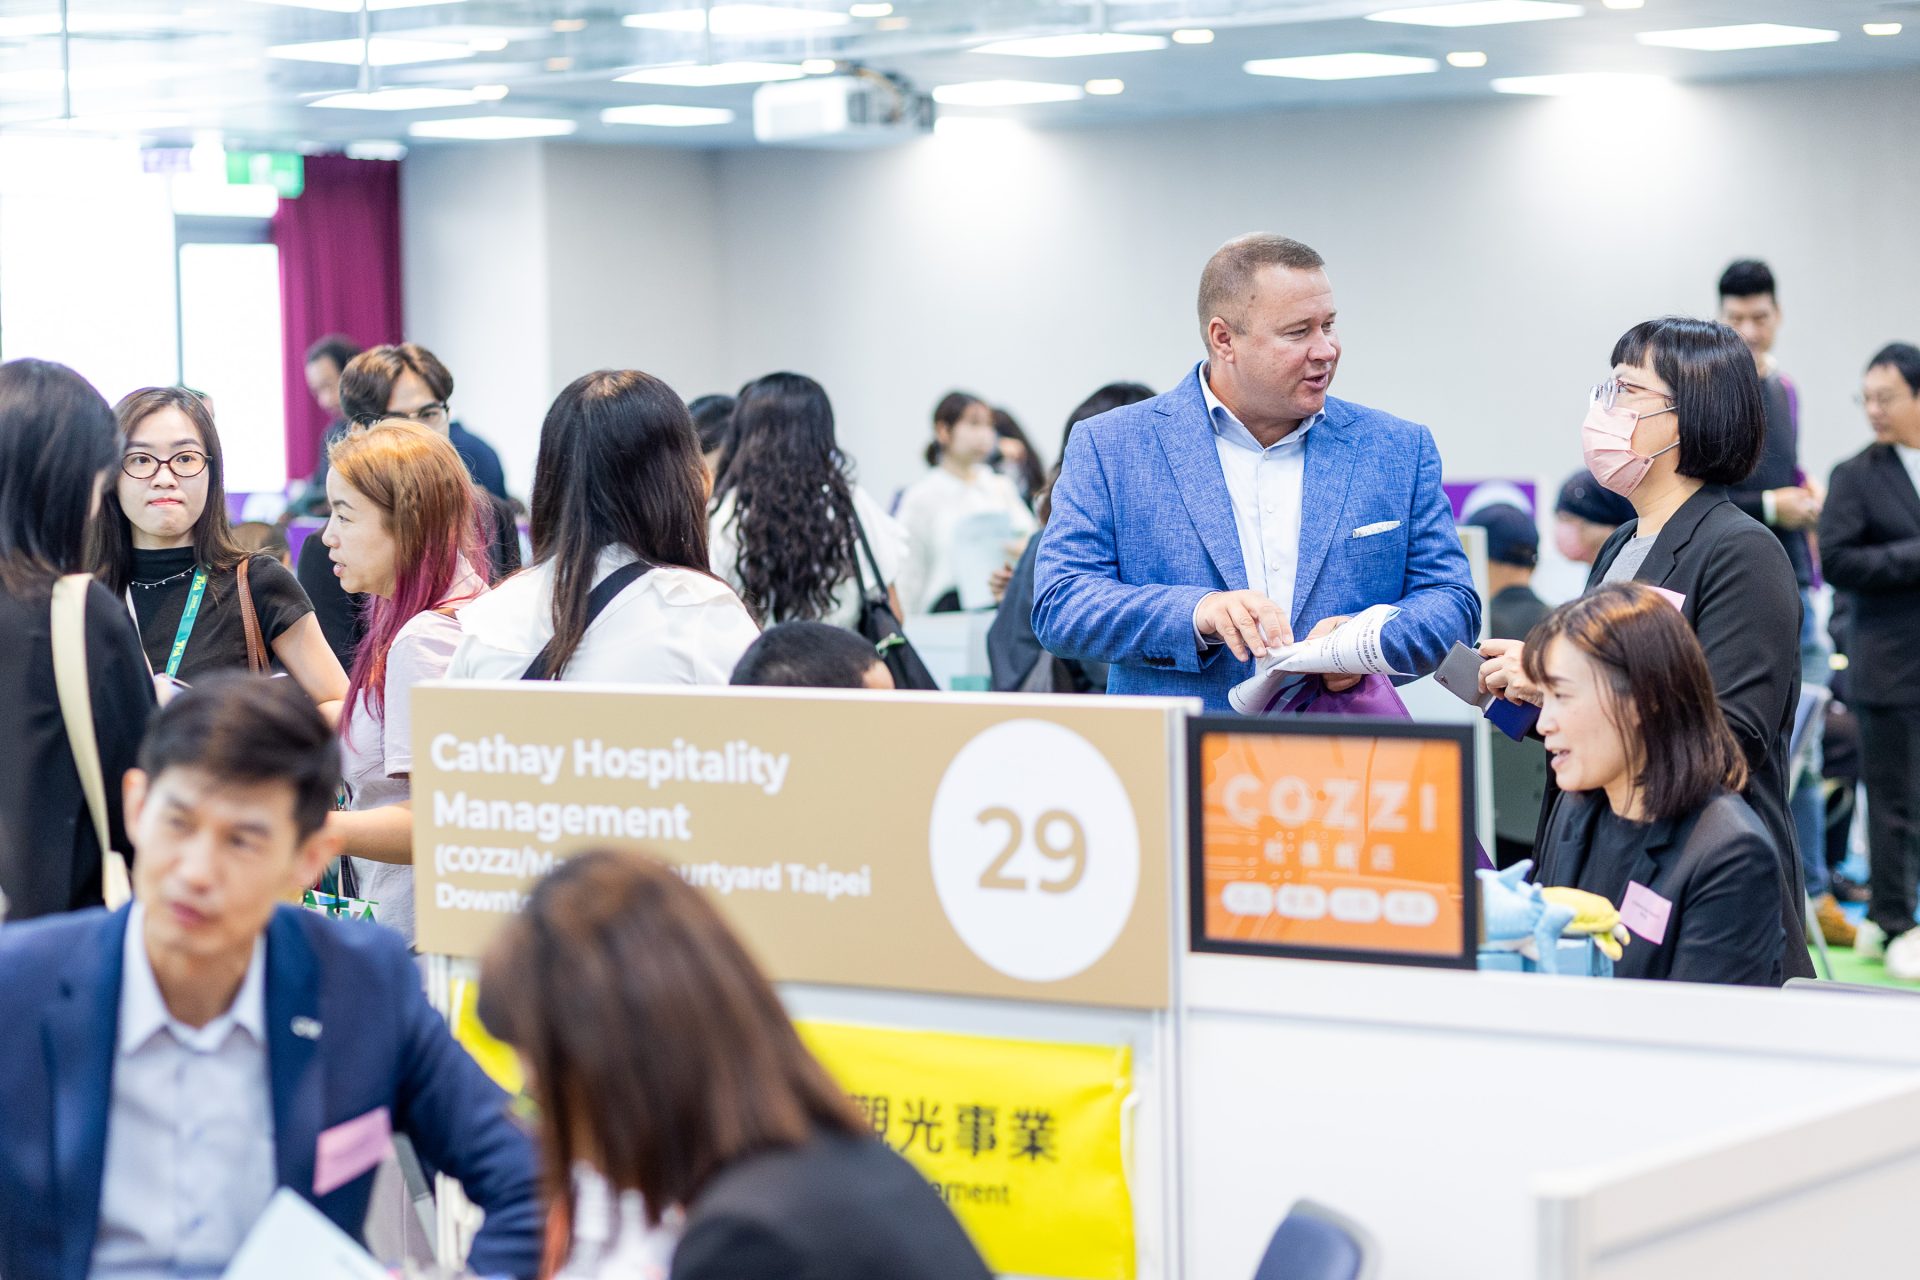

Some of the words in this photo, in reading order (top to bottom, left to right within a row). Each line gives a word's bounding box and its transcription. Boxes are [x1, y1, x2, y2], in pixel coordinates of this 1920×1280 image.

[431, 734, 564, 784] Cathay
[573, 738, 790, 793] Hospitality
[434, 792, 691, 842] Management
[1222, 774, 1438, 833] COZZI
[434, 844, 566, 879] (COZZI/M
[669, 861, 782, 895] urtyard
[785, 862, 871, 901] Taipei
[975, 806, 1087, 894] 29
